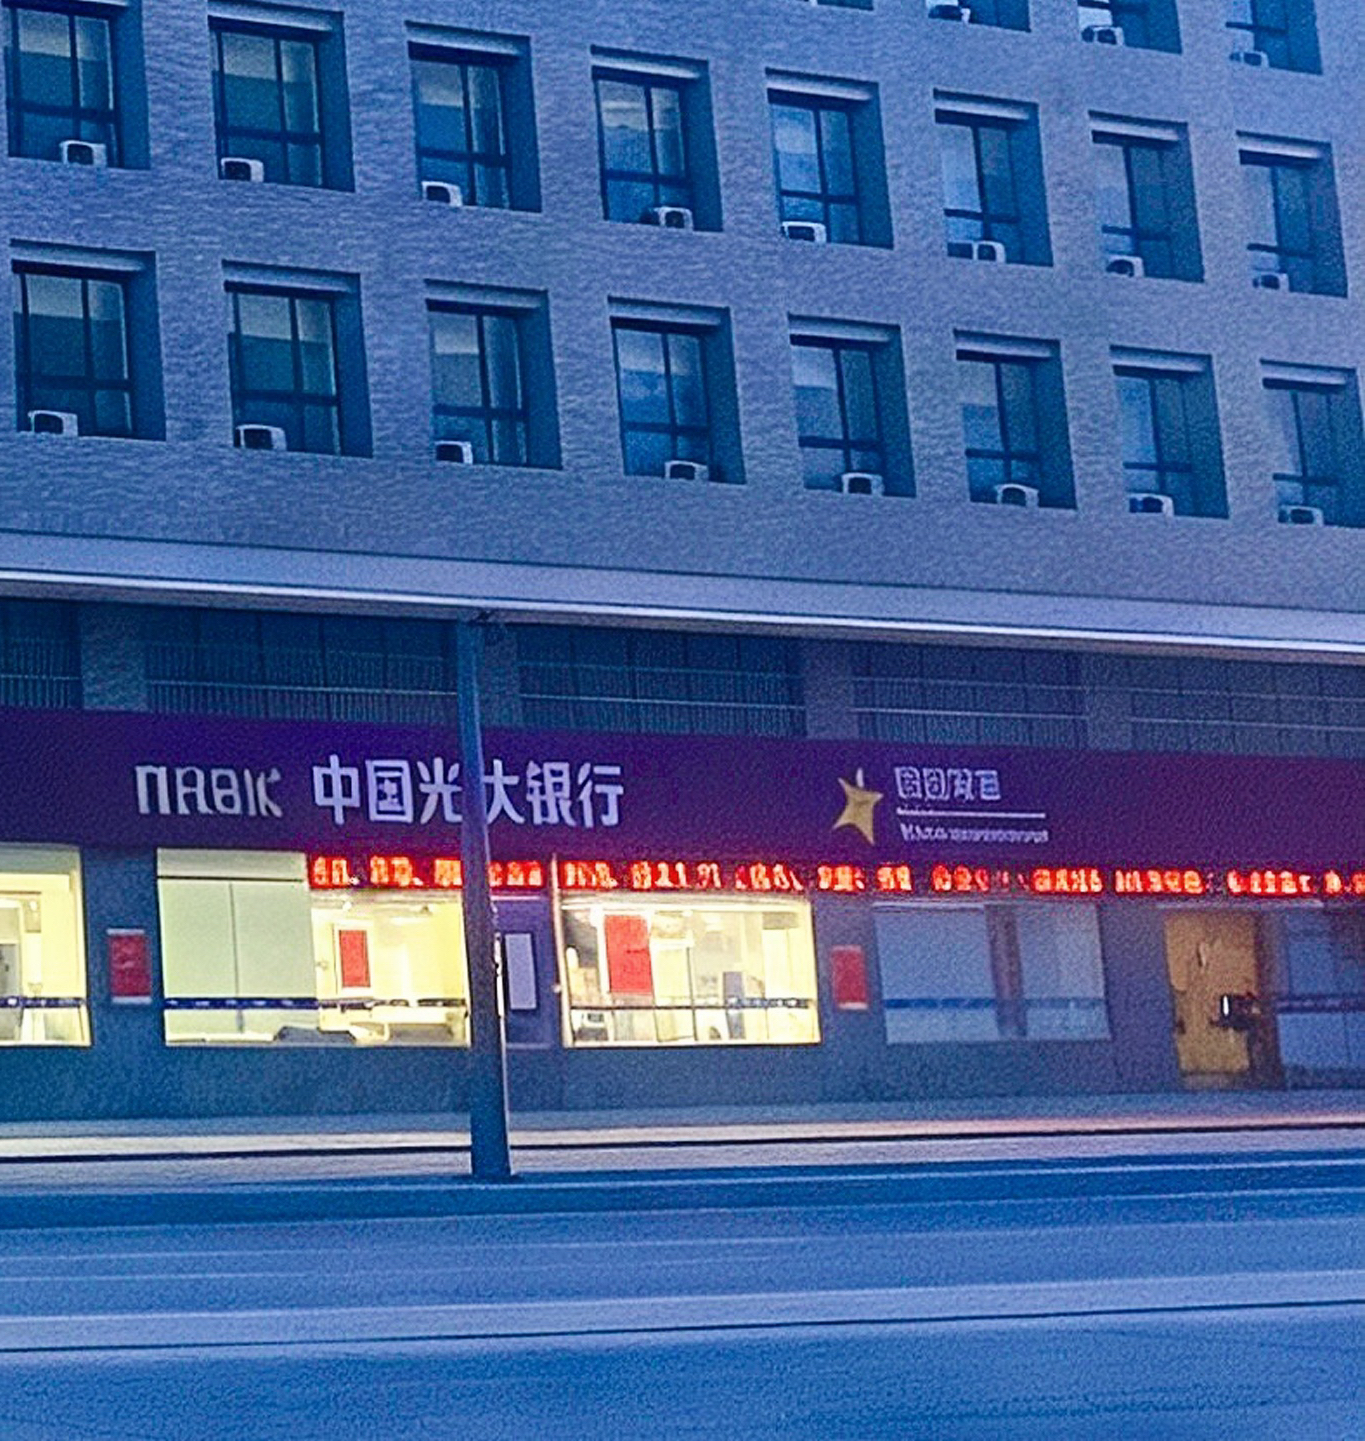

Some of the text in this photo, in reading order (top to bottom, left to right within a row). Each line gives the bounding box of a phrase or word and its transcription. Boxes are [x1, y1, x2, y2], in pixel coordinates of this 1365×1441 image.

[312, 753, 625, 828] 中国光大银行
